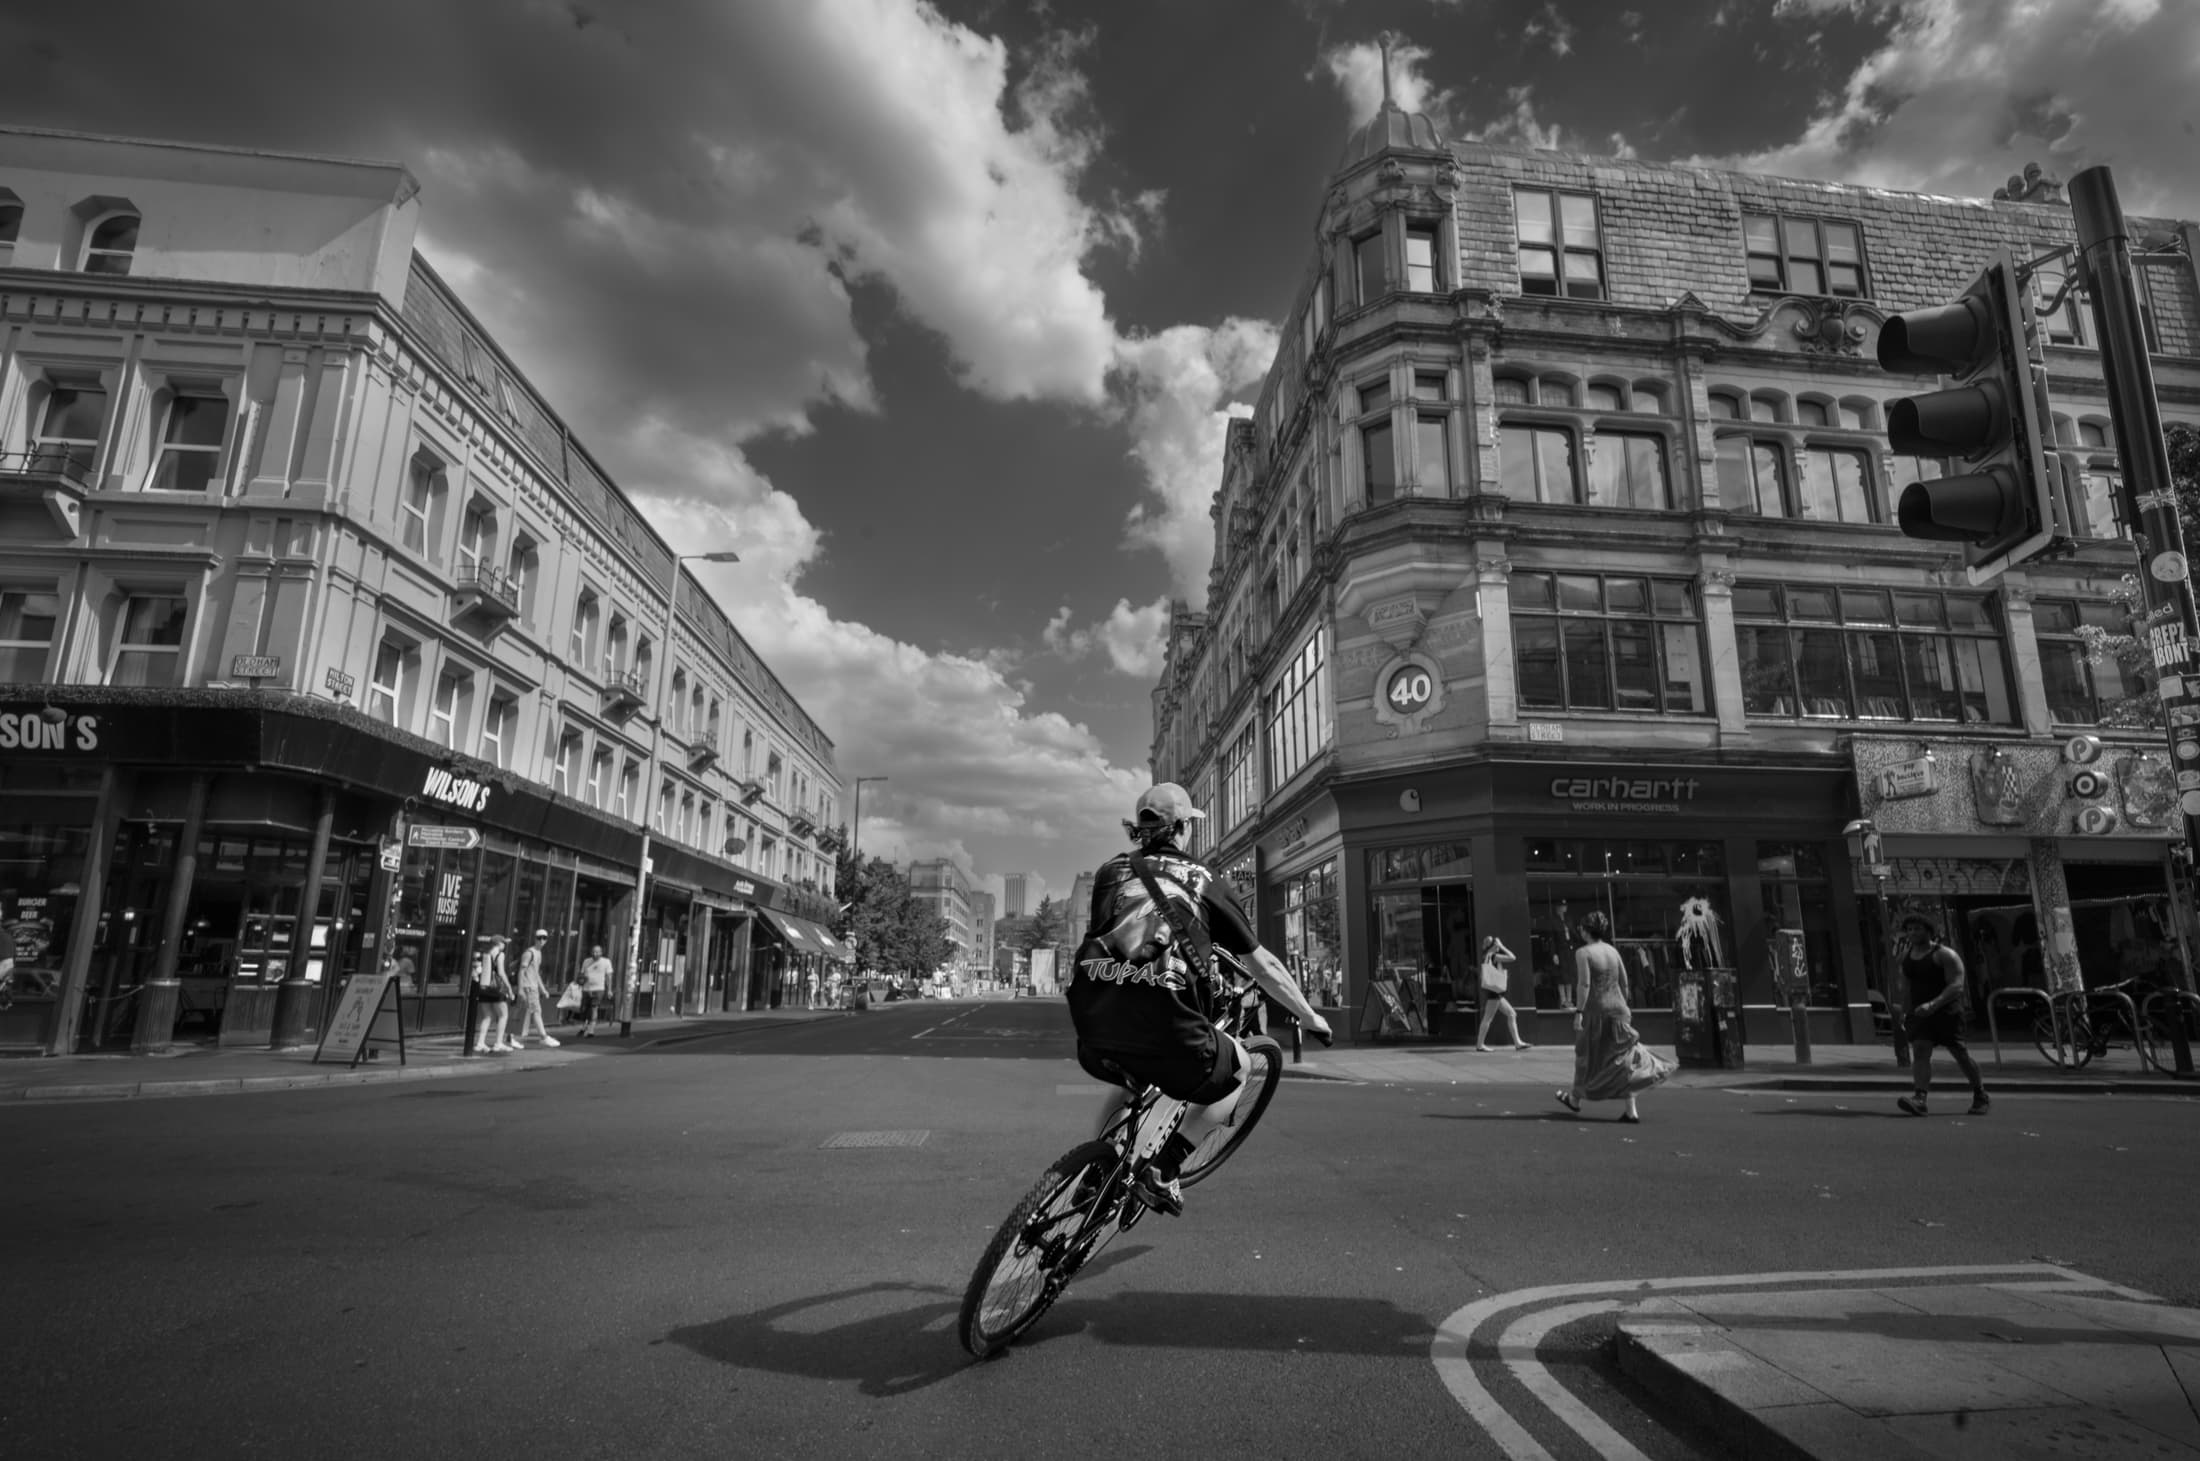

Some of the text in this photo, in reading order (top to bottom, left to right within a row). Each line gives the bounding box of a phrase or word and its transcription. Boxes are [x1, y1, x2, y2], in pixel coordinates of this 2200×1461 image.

[234, 665, 275, 675] STREET
[237, 656, 277, 666] OLDHAM
[326, 679, 352, 697] STREET
[1390, 673, 1431, 706] 40
[1551, 776, 1700, 800] carhartt
[1572, 801, 1680, 813] WORK IN PROGRESS
[440, 872, 463, 899] IVE
[1080, 957, 1187, 992] TUPAC
